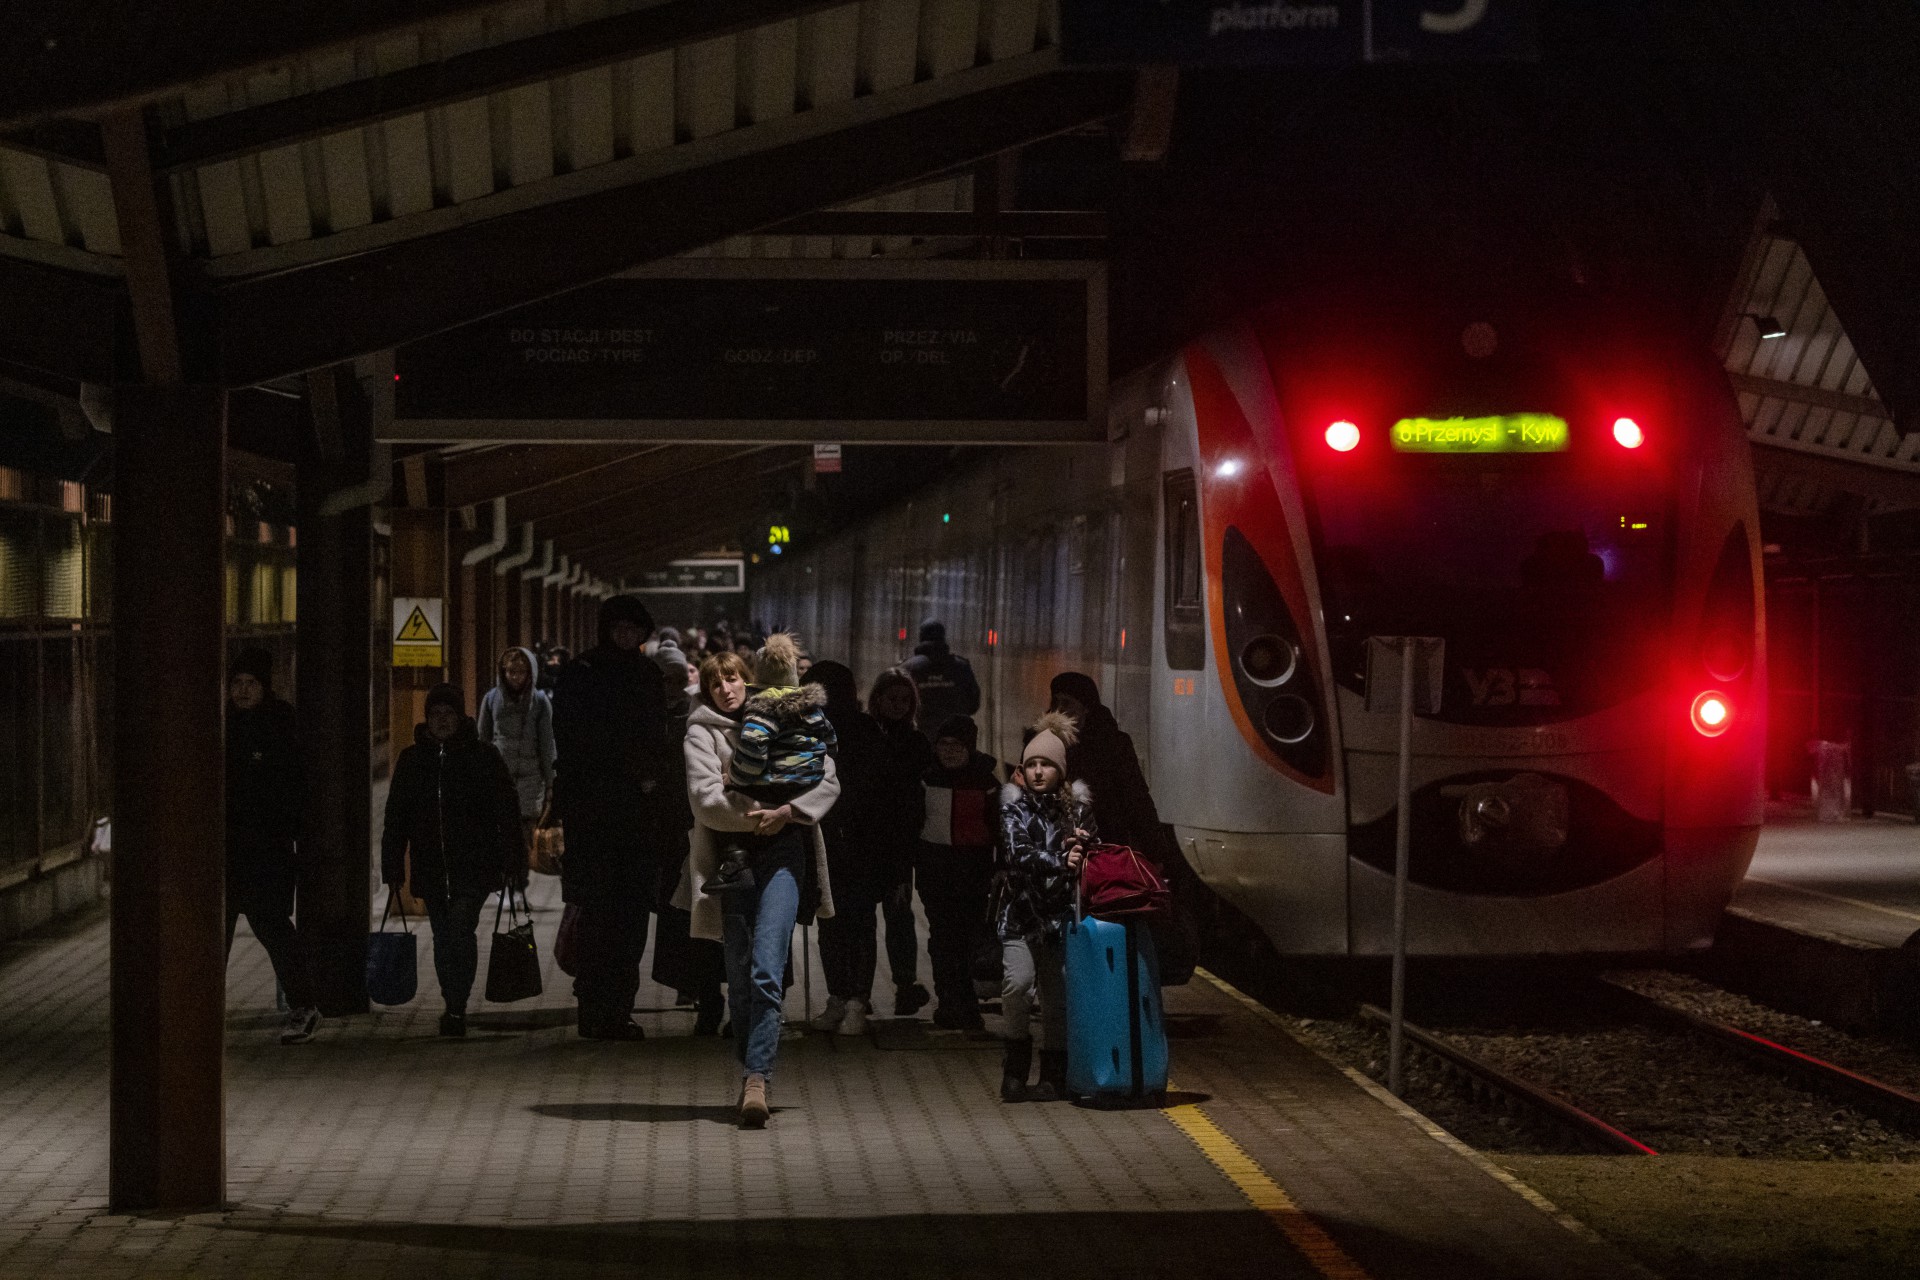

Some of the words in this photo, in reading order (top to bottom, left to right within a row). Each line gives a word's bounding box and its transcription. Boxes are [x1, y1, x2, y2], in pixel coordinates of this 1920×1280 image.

[1208, 2, 1340, 36] platform
[509, 328, 534, 343] DO
[1521, 423, 1560, 444] Kyiv
